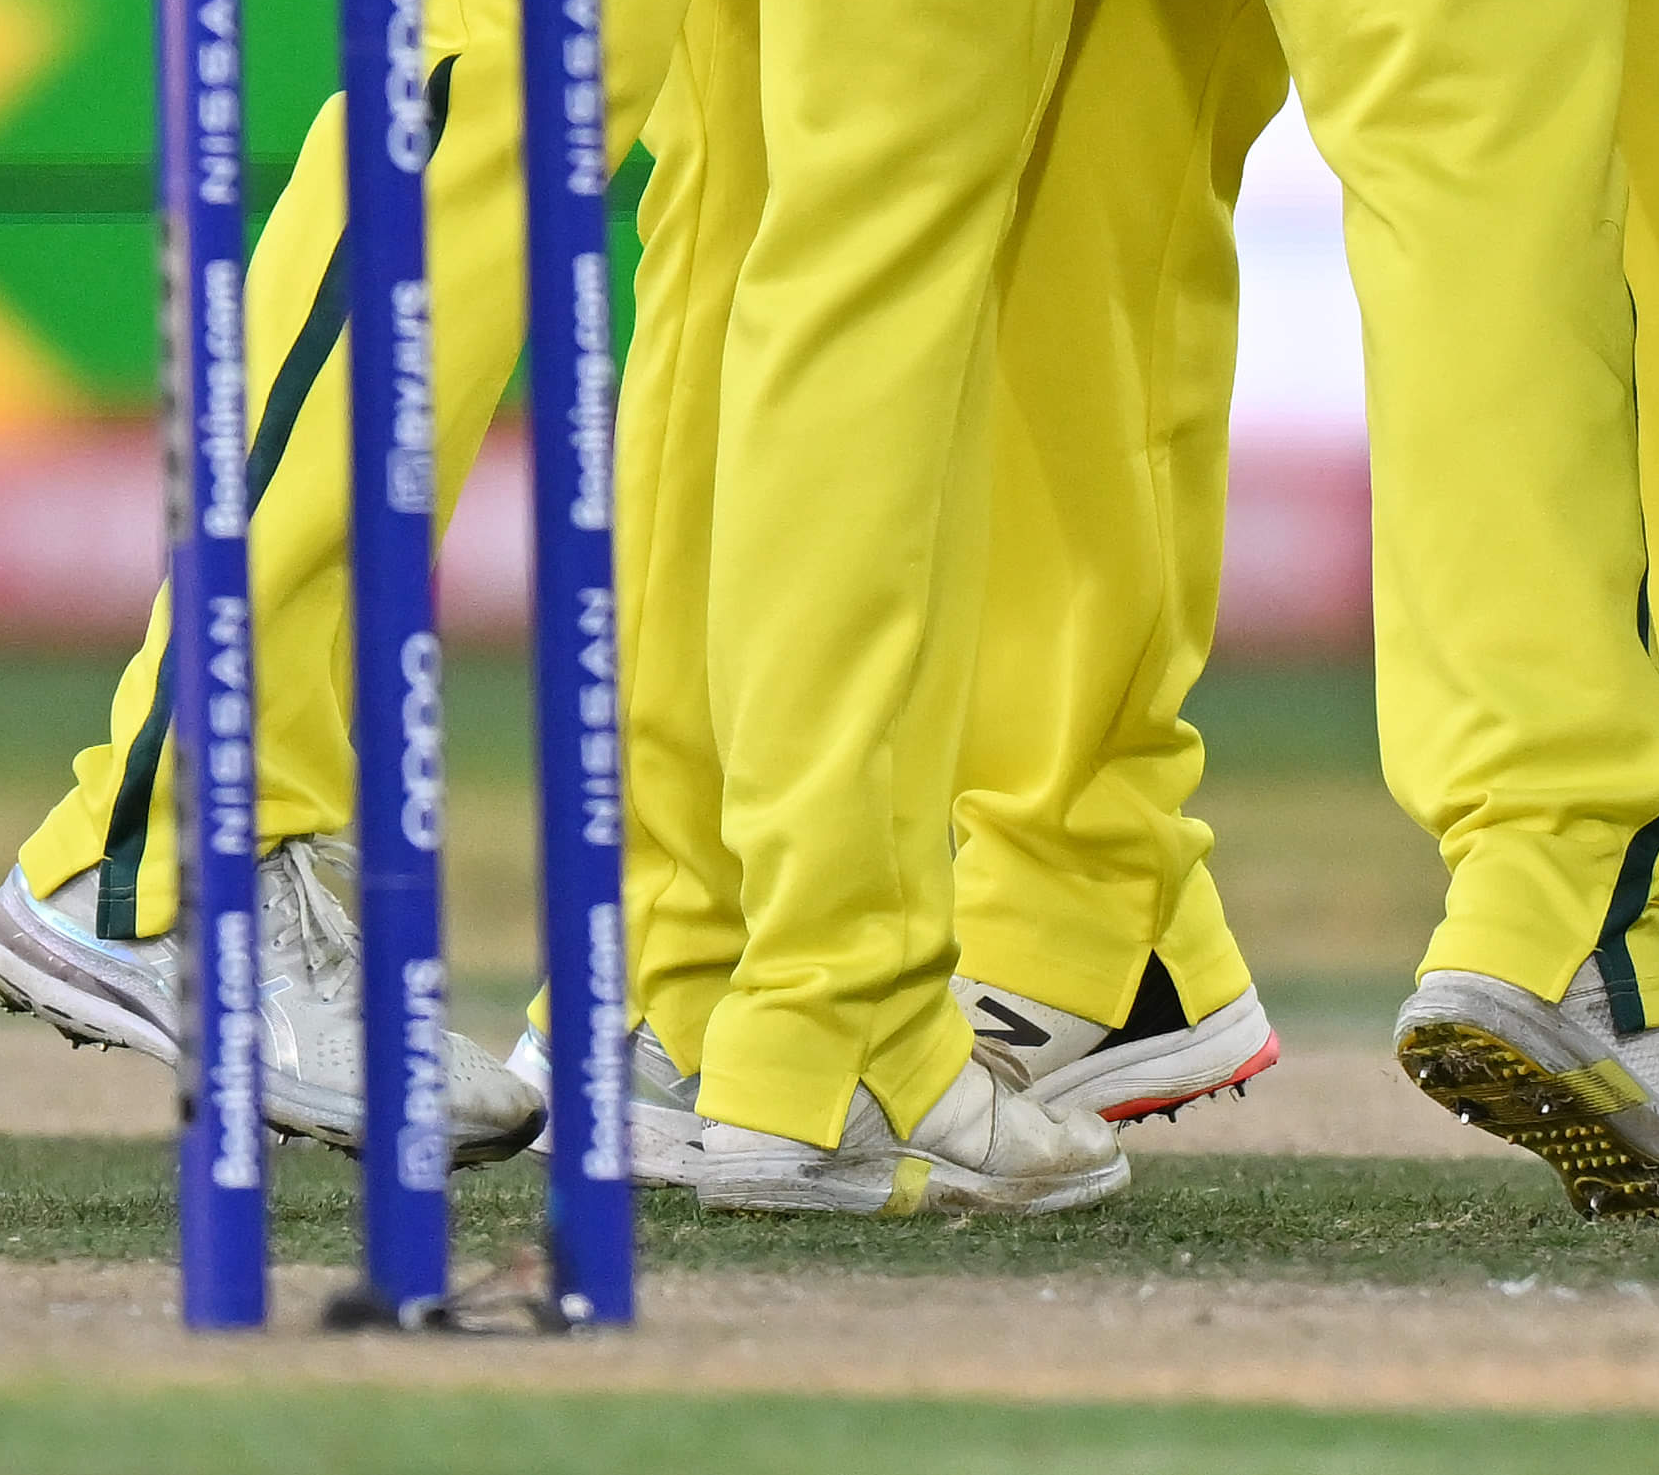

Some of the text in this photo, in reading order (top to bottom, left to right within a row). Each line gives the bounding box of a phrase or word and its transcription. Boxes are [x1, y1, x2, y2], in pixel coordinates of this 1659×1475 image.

[201, 259, 248, 538] Booking.com
[571, 251, 615, 530] Booking.com
[209, 595, 253, 853] NISSAN
[578, 586, 619, 846] NISSAN
[212, 909, 263, 1190] Booking.com
[582, 902, 629, 1182] Booking.com
